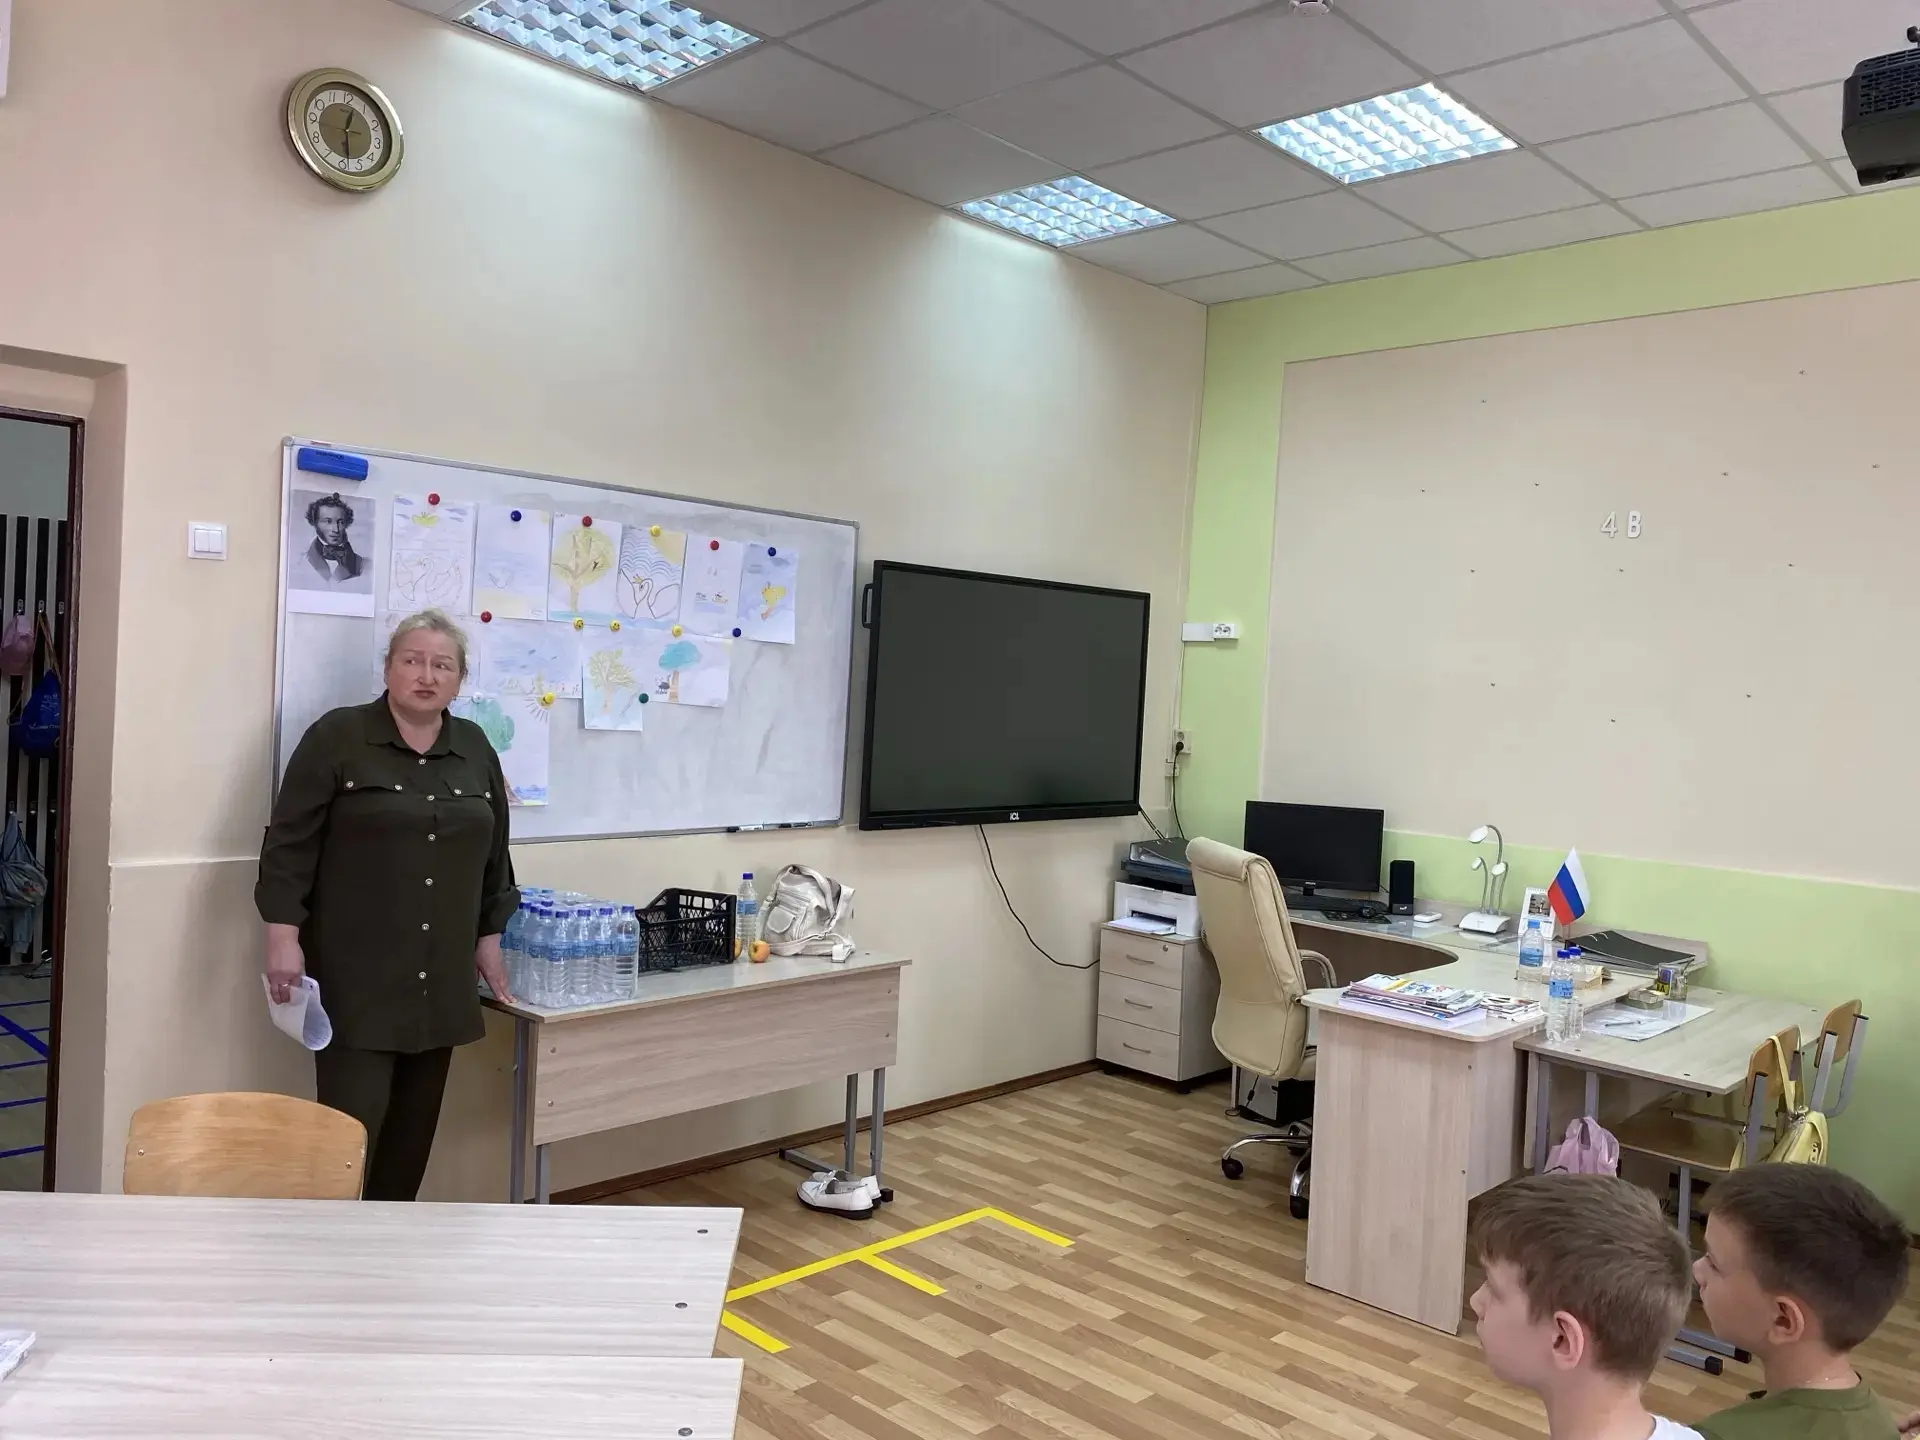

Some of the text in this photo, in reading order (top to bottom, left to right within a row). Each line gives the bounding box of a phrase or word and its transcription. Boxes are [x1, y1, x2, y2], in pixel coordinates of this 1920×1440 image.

[329, 92, 336, 102] 11
[343, 92, 354, 106] 12
[314, 98, 325, 111] 10
[308, 112, 318, 124] 9
[371, 120, 379, 132] 2
[312, 131, 320, 143] 8
[374, 137, 381, 149] 3
[324, 148, 333, 158] 7
[366, 152, 374, 162] 4
[338, 159, 347, 170] 6
[355, 159, 363, 170] 5
